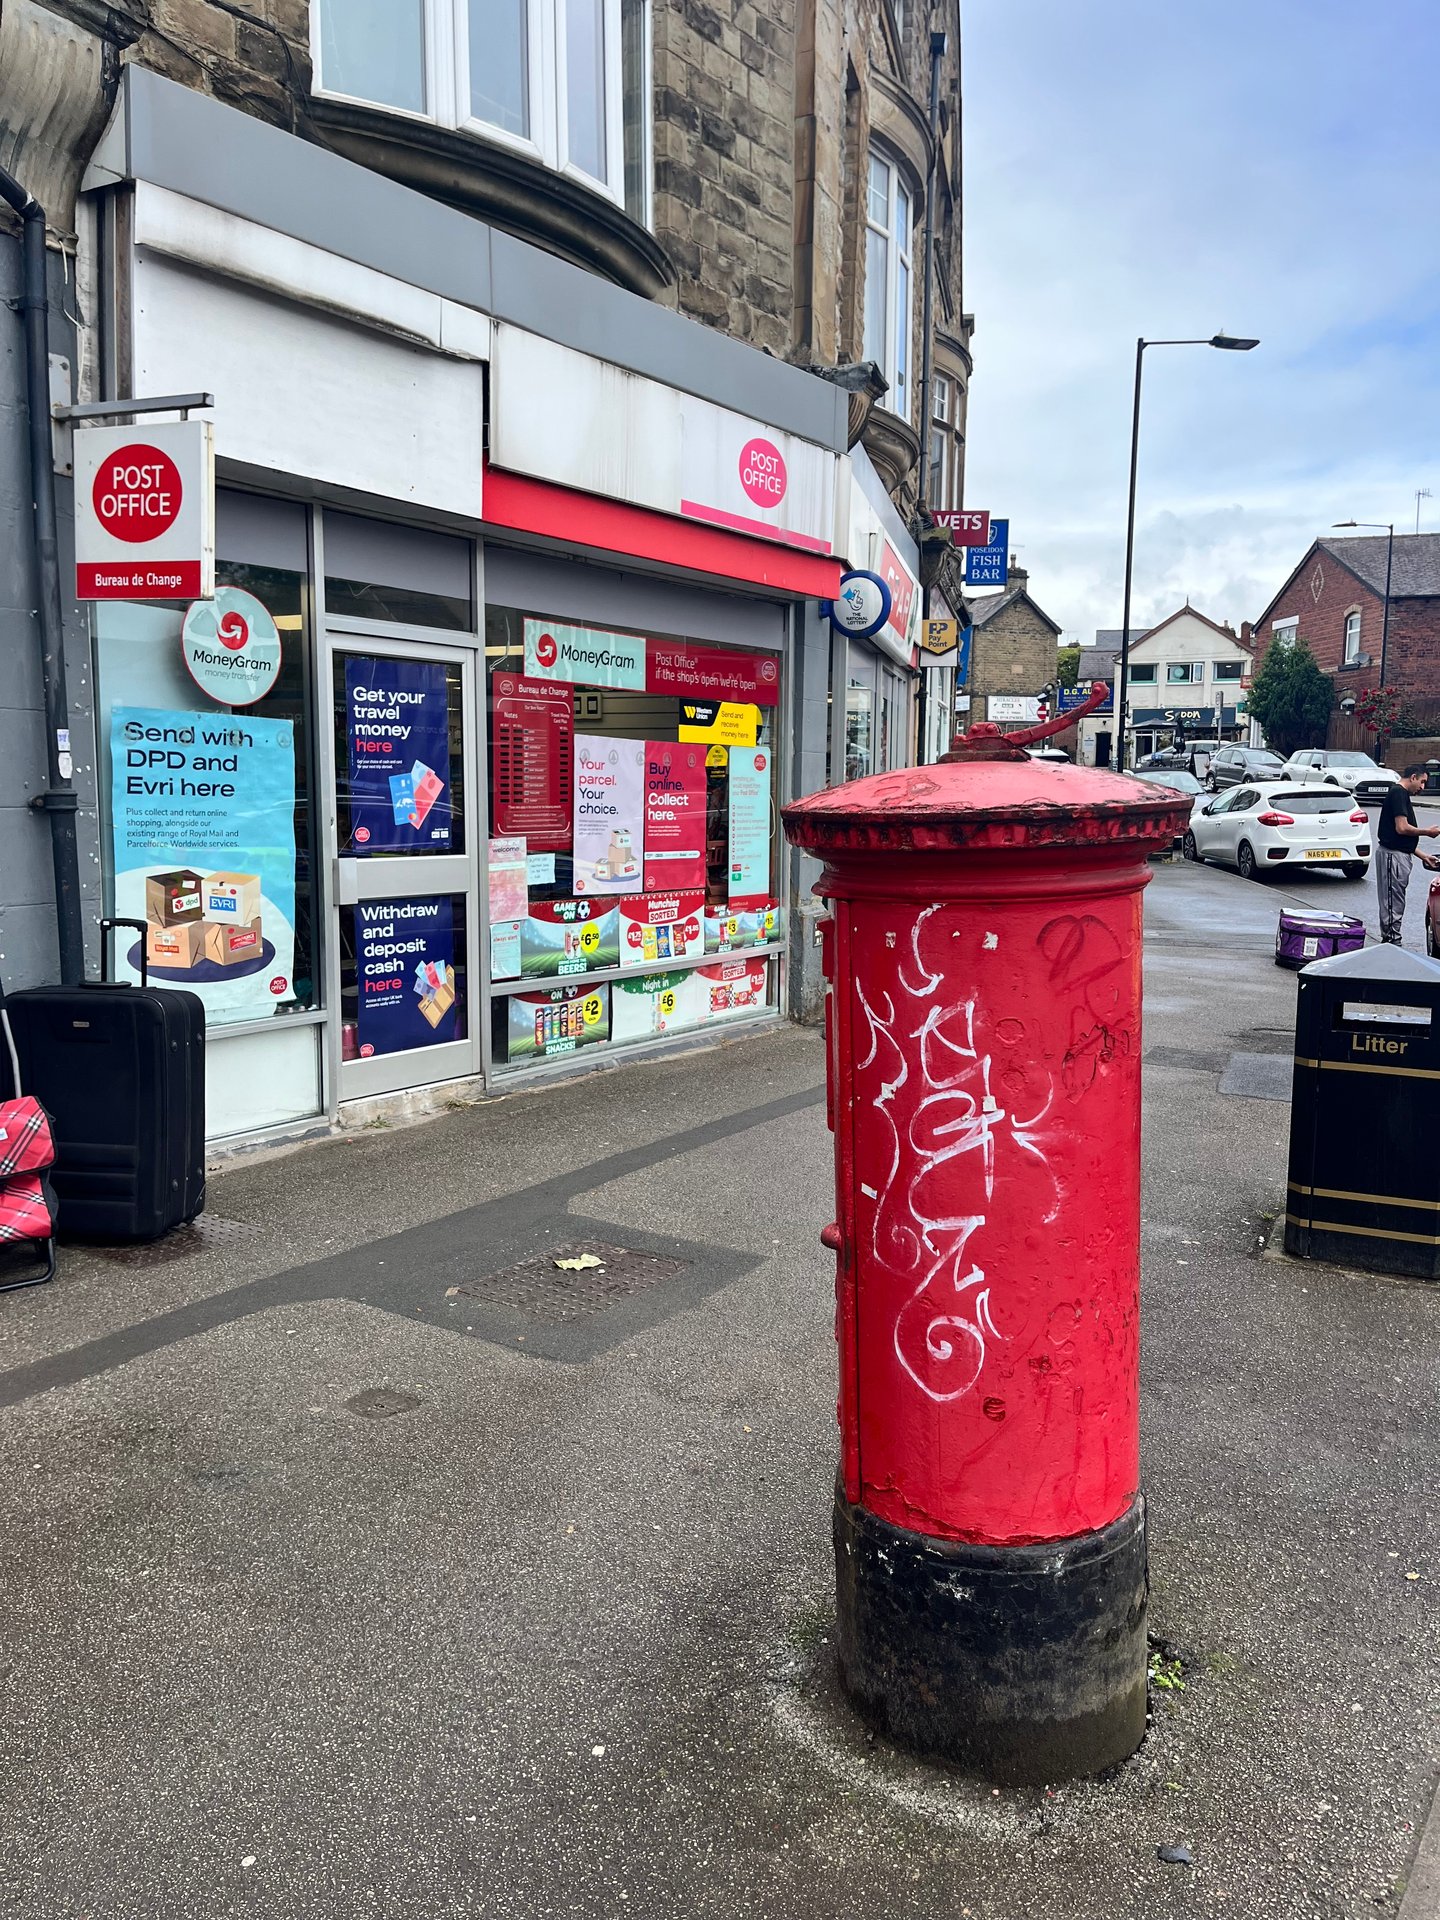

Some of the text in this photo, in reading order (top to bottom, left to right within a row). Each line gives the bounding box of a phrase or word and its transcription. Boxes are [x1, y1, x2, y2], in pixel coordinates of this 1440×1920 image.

[751, 450, 778, 474] POST
[113, 464, 164, 490] POST
[744, 468, 782, 494] OFFICE
[100, 493, 171, 518] OFFICE
[936, 514, 982, 530] VETS
[972, 556, 1001, 566] FISH
[95, 573, 182, 589] Bureau de Change
[972, 569, 1000, 580] BAR
[928, 640, 948, 648] Point
[193, 649, 272, 672] MoneyGram
[561, 644, 635, 670] MoneyGram
[656, 652, 673, 666] Post
[204, 668, 260, 682] money transfer
[656, 667, 756, 693] if the shop's open we're open
[353, 686, 425, 706] Get your
[518, 684, 569, 698] Bureau de Change
[354, 704, 400, 720] travel
[1164, 710, 1200, 722] Soon
[124, 722, 253, 747] Send with
[355, 724, 411, 740] money
[356, 738, 392, 752] here
[126, 749, 238, 772] DPD and
[578, 758, 605, 770] Your
[650, 762, 670, 778] Buy
[126, 776, 235, 797] Evri here
[578, 774, 616, 787] parcel.
[649, 778, 684, 791] online.
[578, 788, 604, 800] Your
[648, 792, 689, 806] Collect
[126, 808, 142, 816] Plus
[144, 808, 168, 816] collect
[578, 802, 619, 815] choice.
[648, 808, 677, 820] here.
[126, 819, 164, 828] shopping,
[165, 820, 199, 828] alongside
[126, 830, 156, 838] existing
[189, 830, 208, 838] Royal
[126, 840, 240, 848] Parcelforce Worldwide services.
[1308, 850, 1324, 858] NA65
[185, 896, 198, 907] dpd
[211, 898, 235, 910] EVRI
[553, 902, 576, 912] GAME
[648, 898, 680, 910] Munchies
[361, 904, 438, 922] Withdraw
[563, 911, 576, 920] ON
[650, 910, 676, 921] SORTED.
[362, 924, 394, 940] and
[728, 923, 736, 932] £3
[581, 933, 600, 946] £6.50
[364, 938, 426, 958] deposit
[364, 958, 404, 975] cash
[558, 962, 587, 975] BEERS!
[724, 968, 744, 978] SORTED.
[270, 984, 286, 992] OFFICE
[274, 978, 284, 986] POST
[364, 978, 402, 992] here
[642, 978, 670, 992] Night in
[550, 990, 563, 1000] ON
[662, 994, 674, 1006] £6
[585, 1000, 599, 1015] £2
[546, 1041, 576, 1055] SNACKS!
[1352, 1034, 1408, 1054] Litter
